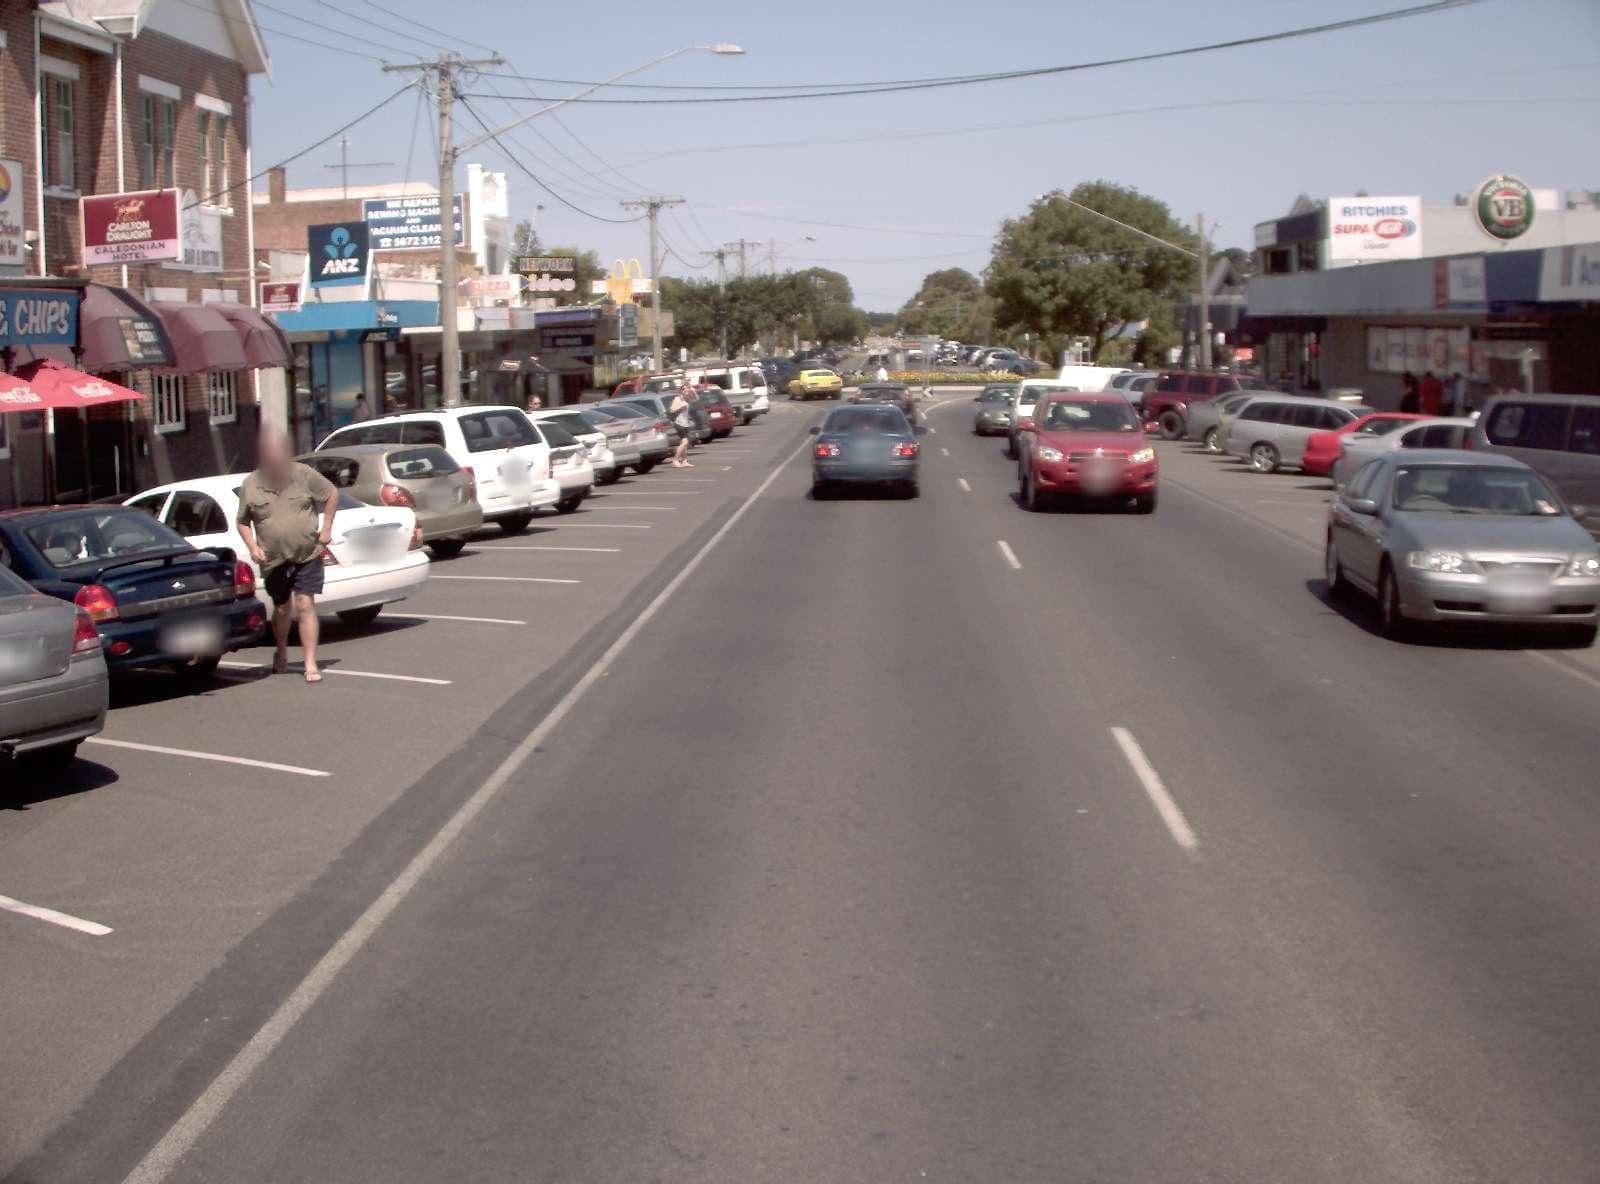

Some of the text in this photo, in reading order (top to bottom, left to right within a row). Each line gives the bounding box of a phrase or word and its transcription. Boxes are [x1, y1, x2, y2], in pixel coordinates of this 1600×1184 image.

[403, 198, 439, 207] REPAIR
[1493, 199, 1521, 217] VB
[367, 209, 407, 219] SEWING
[1342, 205, 1408, 217] RITCHIES
[108, 220, 150, 232] CARLTON
[370, 225, 409, 235] ACUUM
[1334, 224, 1370, 234] SUPA
[106, 229, 152, 241] DRAUGHT
[94, 241, 166, 255] CALEDONIAN
[112, 252, 148, 261] HOTEL
[321, 258, 360, 275] ANZ
[15, 300, 70, 335] CHIPS
